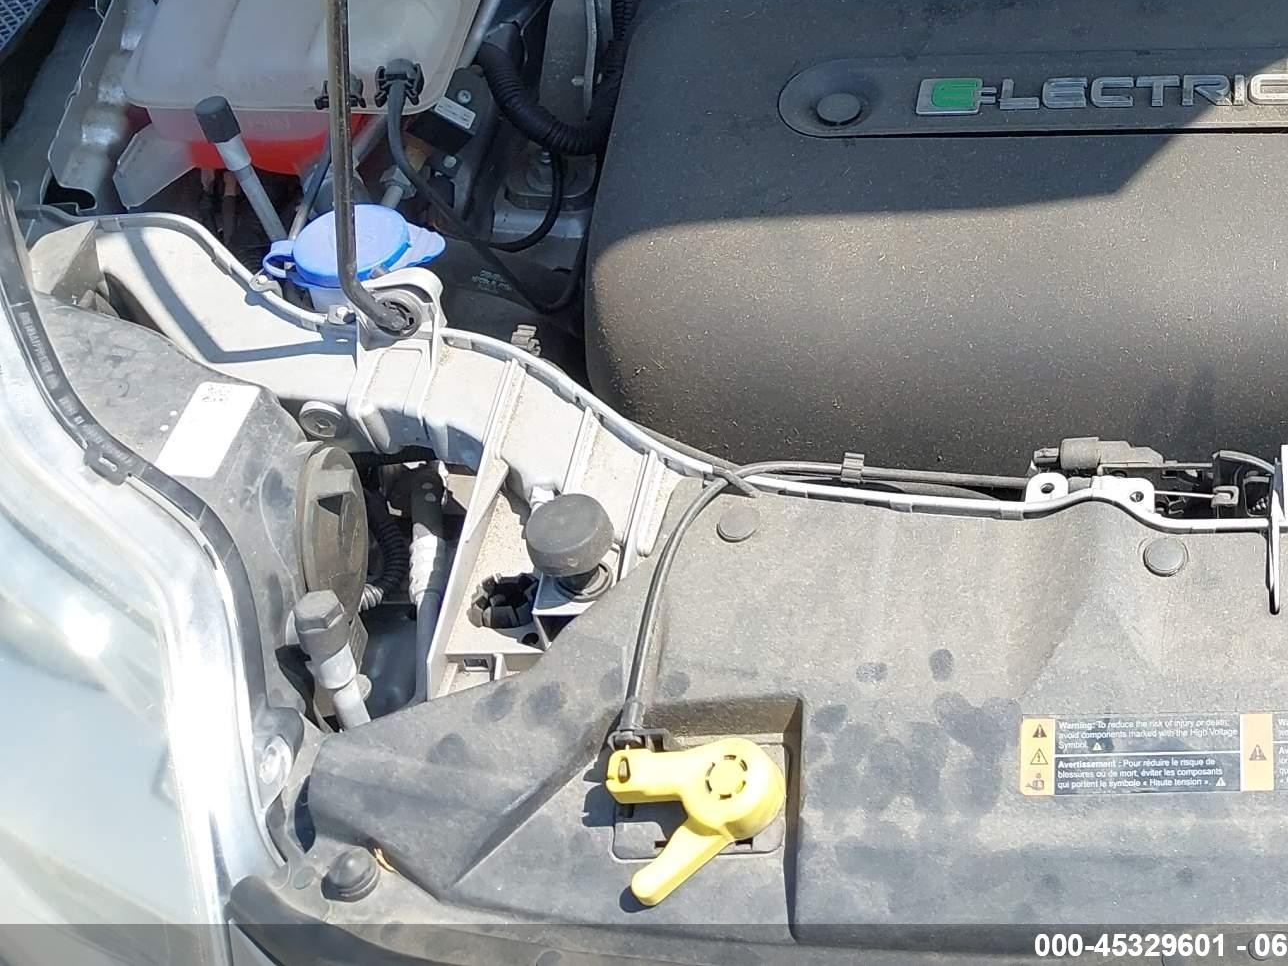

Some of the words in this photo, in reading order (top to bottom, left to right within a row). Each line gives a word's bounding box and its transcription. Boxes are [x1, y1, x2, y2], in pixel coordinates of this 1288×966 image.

[1058, 721, 1095, 730] Warning:
[1097, 721, 1106, 729] To
[1108, 721, 1133, 729] reduce
[1136, 720, 1147, 728] the
[1150, 719, 1162, 727] risk
[1165, 719, 1173, 727] of
[1175, 719, 1194, 728] injury
[1058, 731, 1080, 739] avoid
[1081, 731, 1127, 740] components
[1129, 730, 1156, 738] marked
[1176, 729, 1188, 737] the
[1190, 728, 1208, 738] High
[1210, 728, 1238, 737] Voltage
[1058, 759, 1116, 769] Avertissement
[1123, 759, 1141, 767] Pour
[1143, 758, 1170, 766] réduire
[1171, 757, 1179, 766] le
[1180, 758, 1204, 768] risque
[1205, 757, 1216, 766] de
[1058, 770, 1094, 779] blessures
[1108, 769, 1118, 777] de
[1141, 768, 1162, 777] éviter
[1176, 768, 1223, 777] composants
[1058, 780, 1069, 790] qui
[1072, 780, 1098, 790] portent
[1108, 779, 1141, 789] symbole
[1149, 778, 1173, 786] Haute
[1174, 777, 1202, 786] tension
